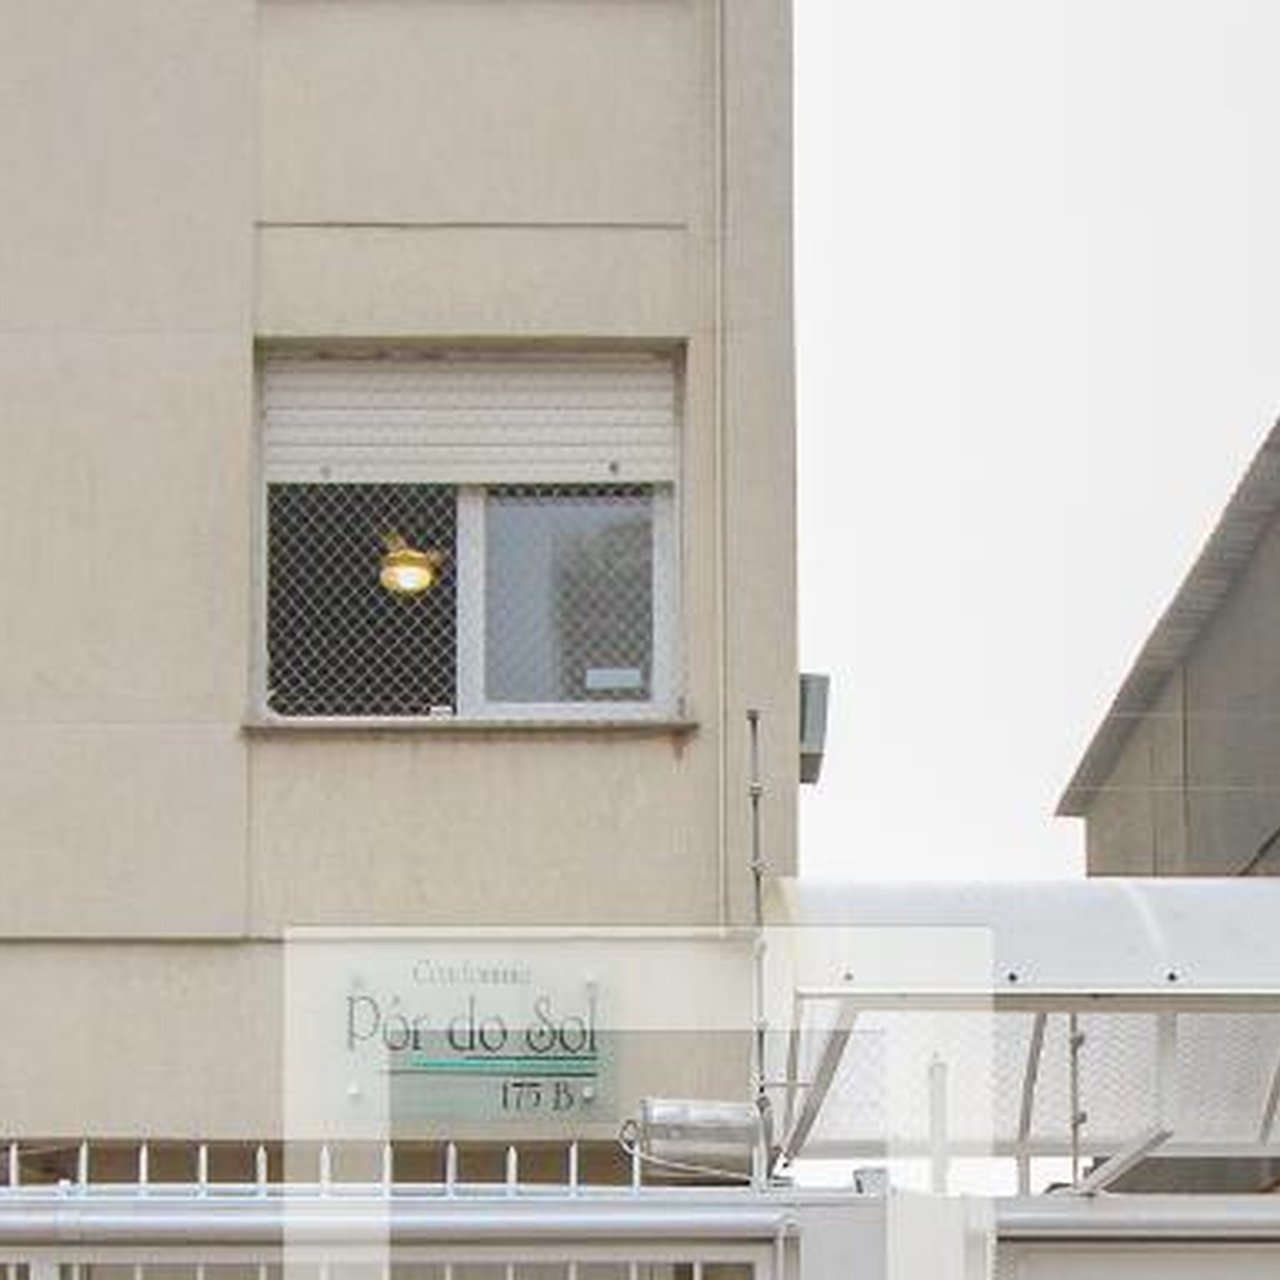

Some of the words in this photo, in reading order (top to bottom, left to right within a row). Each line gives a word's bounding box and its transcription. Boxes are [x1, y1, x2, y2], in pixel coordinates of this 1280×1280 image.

[448, 994, 508, 1052] do
[525, 988, 597, 1053] Sol
[501, 1080, 542, 1110] 175
